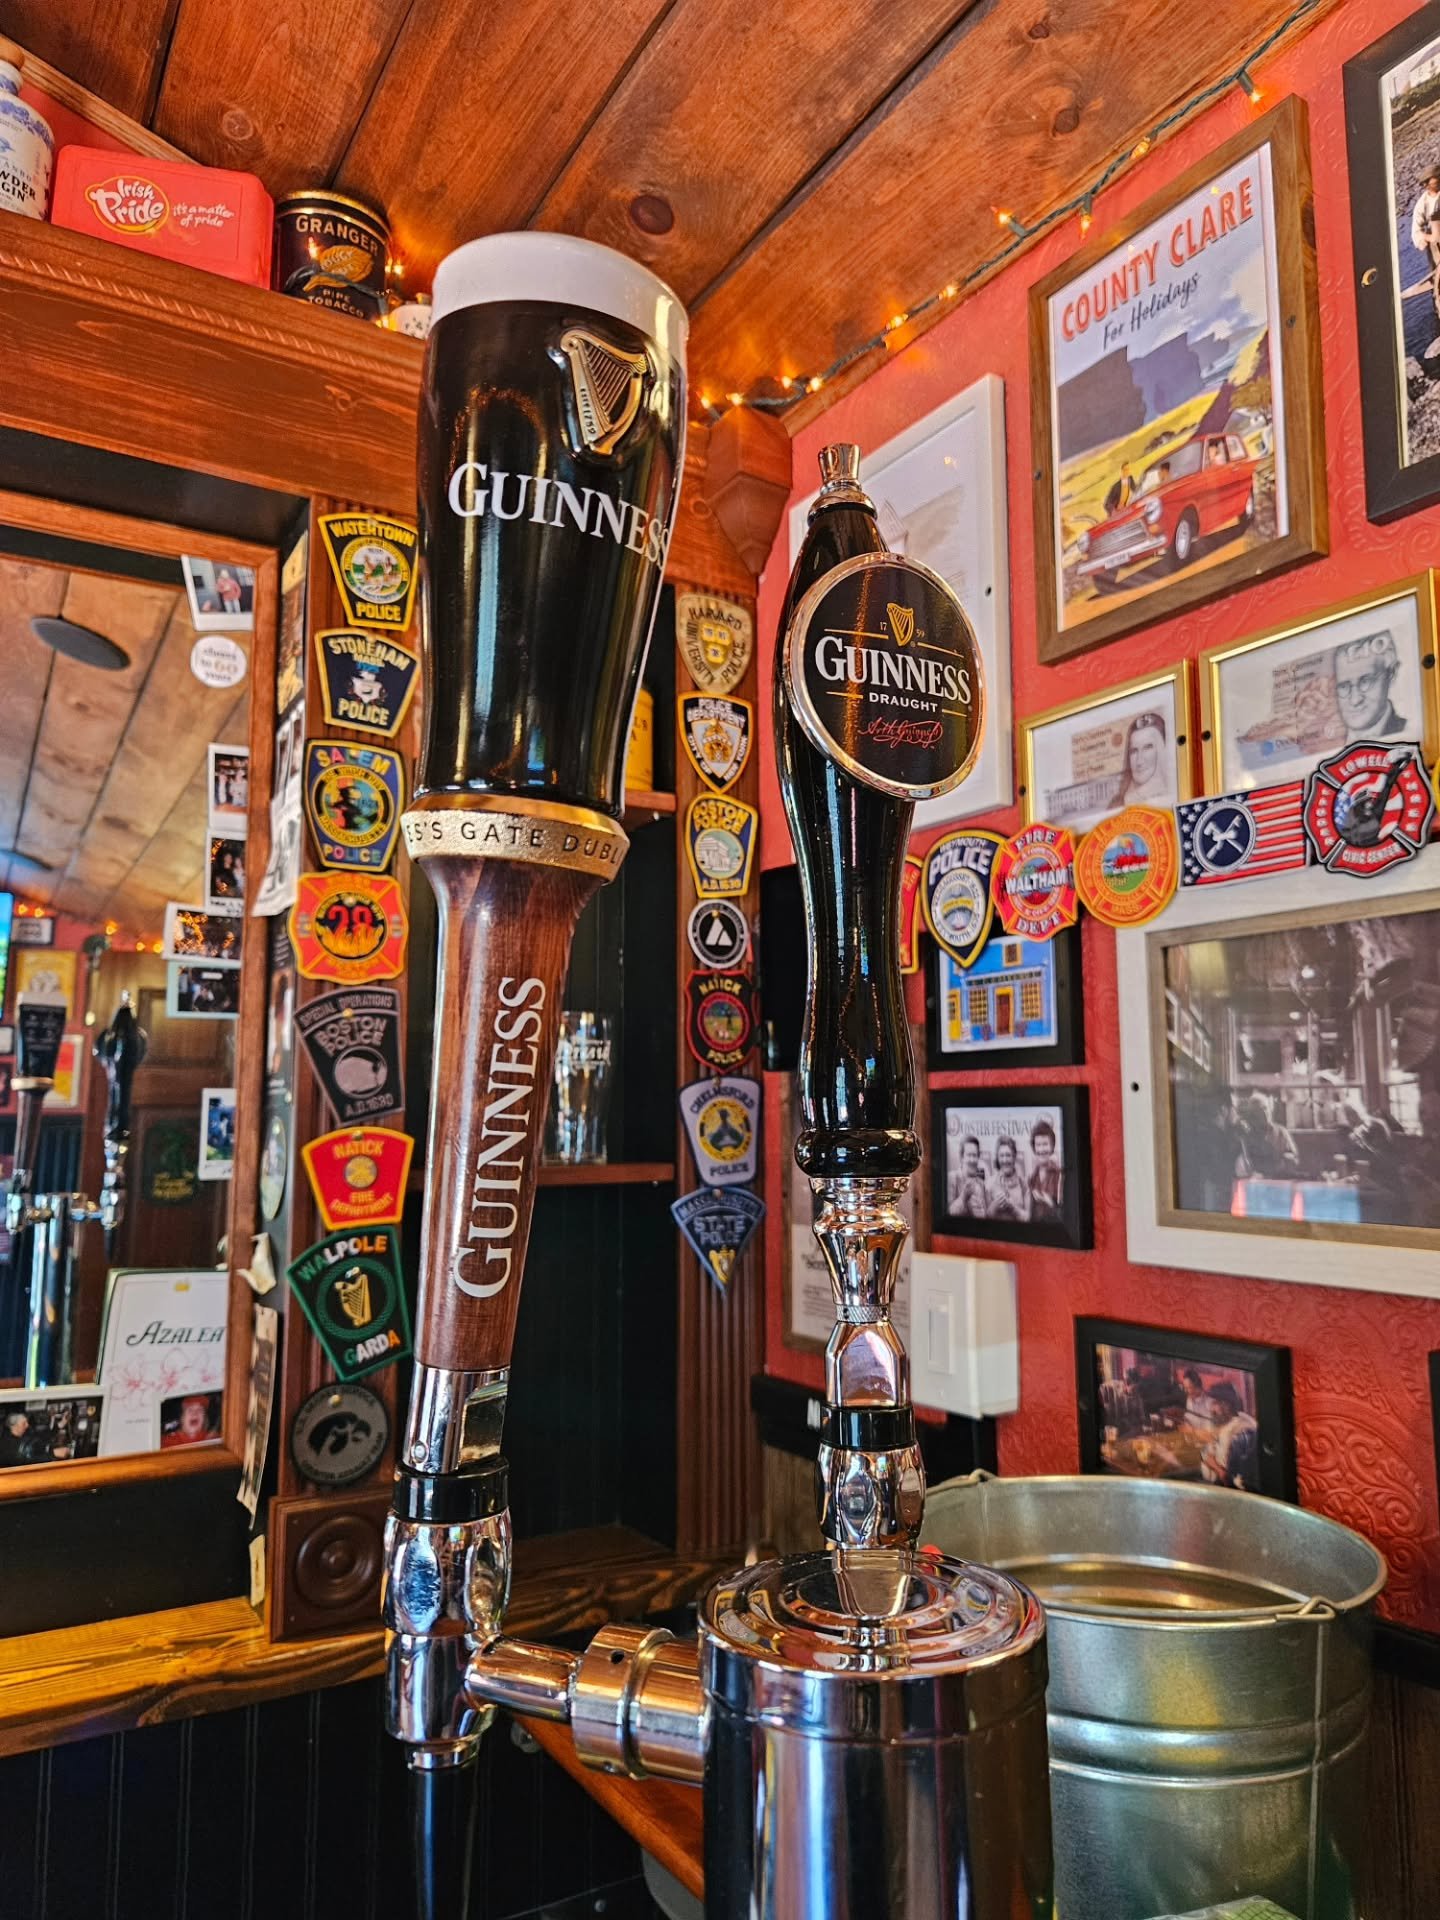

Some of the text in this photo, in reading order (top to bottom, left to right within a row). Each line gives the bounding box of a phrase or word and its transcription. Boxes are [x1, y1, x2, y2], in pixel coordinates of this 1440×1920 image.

[1, 181, 26, 202] GIN
[117, 179, 155, 200] Irish
[89, 188, 164, 224] Pride
[198, 203, 234, 219] matter
[180, 214, 224, 227] of pride
[295, 214, 379, 256] GRANGER
[1061, 176, 1254, 342] COUNTY CLARE
[307, 295, 365, 318] TOBACCO
[322, 288, 351, 303] PIPE
[1103, 271, 1201, 350] For Holidays
[329, 521, 415, 547] WATERTOWN
[356, 601, 401, 621] POLICE
[688, 607, 742, 630] HARVARD
[879, 621, 887, 631] 17
[328, 636, 410, 671] STONEHAM
[721, 640, 745, 684] POLICE
[815, 635, 972, 705] GUINNESS
[337, 698, 390, 726] POLICE
[698, 698, 733, 711] POLICE
[869, 692, 939, 713] DRAUGHT
[686, 706, 747, 729] DEPARTMENT
[316, 747, 391, 776] SALEM
[1338, 754, 1390, 777] LOWELL
[693, 800, 750, 827] BOSTON
[694, 816, 742, 835] POLICE
[461, 822, 543, 848] GATE
[1015, 830, 1056, 851] FIRE
[323, 843, 381, 863] POLICE
[929, 846, 992, 886] POLICE
[1005, 866, 1068, 896] WALTHAM
[327, 905, 374, 938] 28
[1016, 911, 1060, 934] DEPT
[699, 977, 742, 996] NATICK
[300, 993, 393, 1026] SPECIAL OPERATIONS
[314, 1015, 387, 1047] BOSTON
[324, 1030, 383, 1058] POLICE
[707, 1049, 745, 1064] POLICE
[690, 1086, 755, 1114] CHELMSFORD
[454, 976, 546, 1298] GUINNESS
[333, 1139, 385, 1160] NATICK
[709, 1162, 749, 1177] POLICE
[329, 1192, 394, 1217] DEPARTMENT
[349, 1190, 375, 1204] FIRE
[694, 1215, 745, 1233] STATE
[700, 1231, 741, 1245] POLICE
[298, 1235, 388, 1281] WALPOLE
[126, 1320, 225, 1346] AZALEA
[344, 1329, 400, 1364] GARDA
